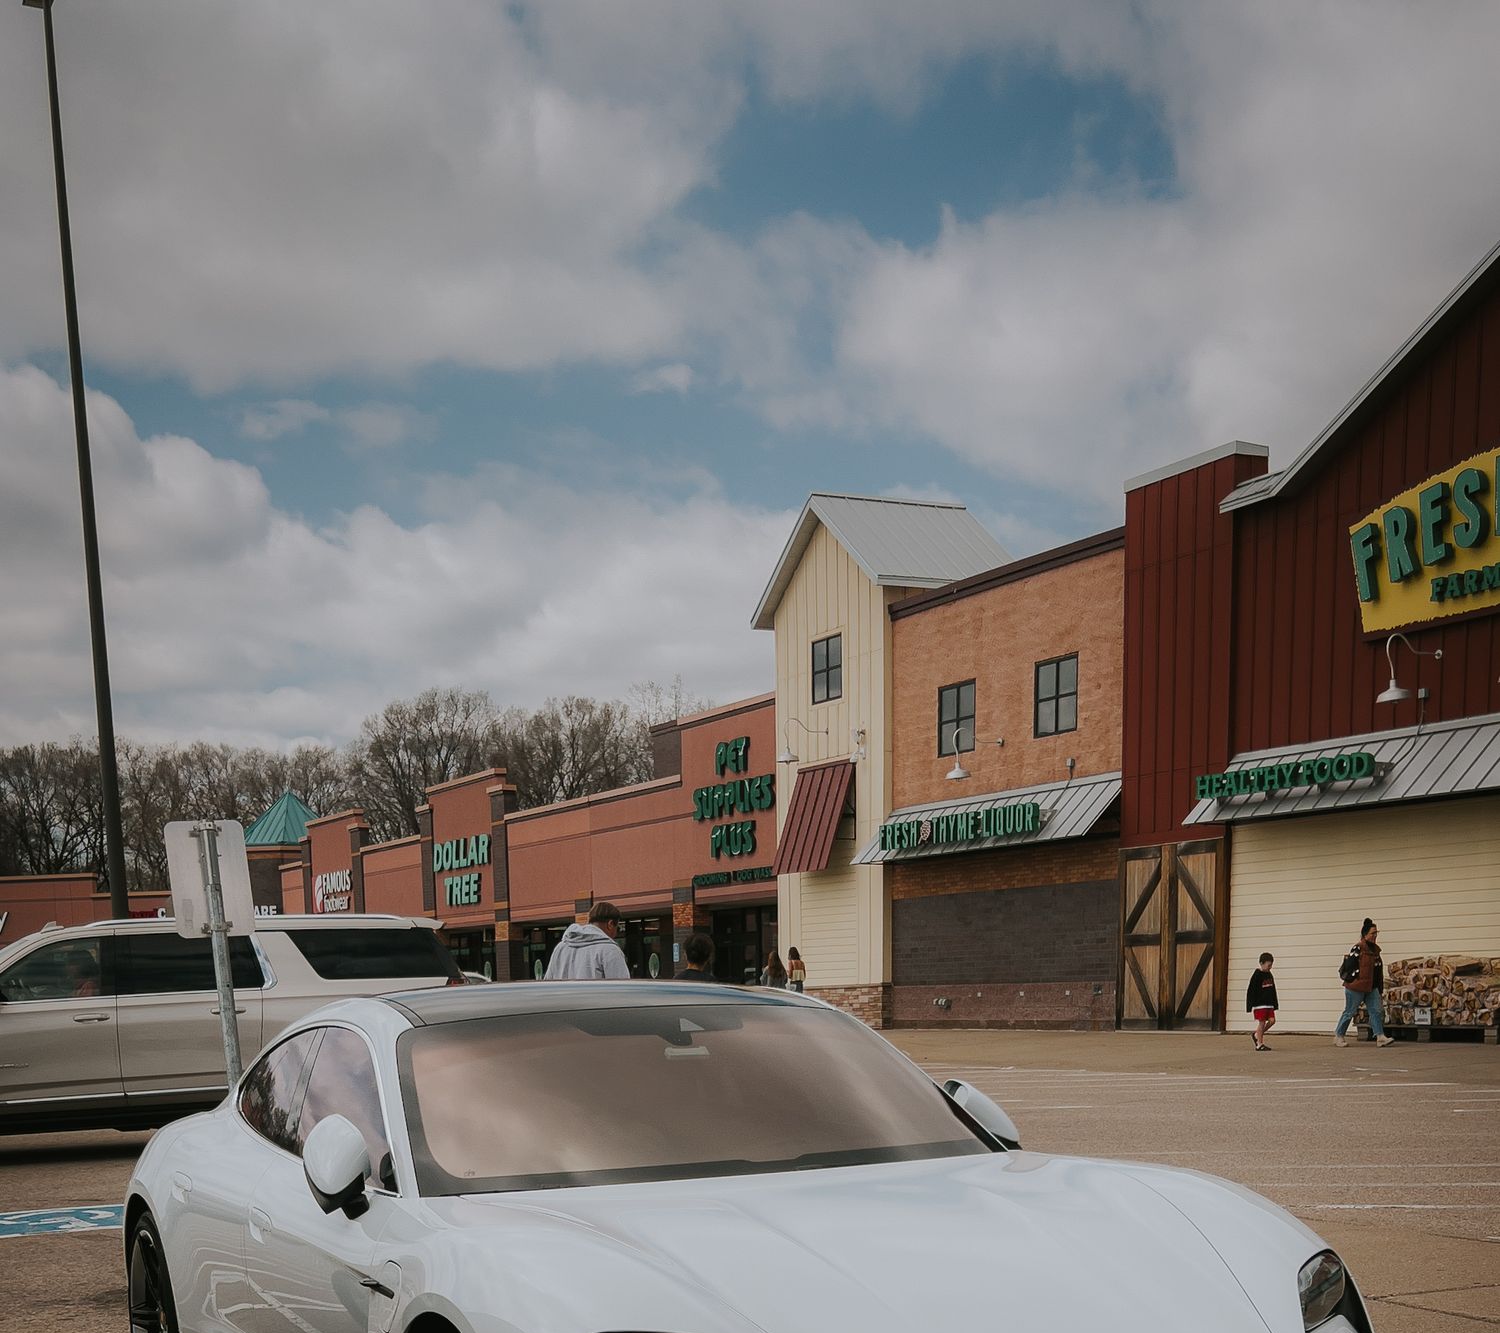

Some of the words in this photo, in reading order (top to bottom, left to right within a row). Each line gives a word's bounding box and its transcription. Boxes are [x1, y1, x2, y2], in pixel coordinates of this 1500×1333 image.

[1351, 456, 1500, 602] FRES
[715, 736, 750, 777] PET
[1196, 762, 1298, 800] HEALTHY
[1300, 752, 1375, 786] FOOD
[693, 773, 775, 821] SUPPLIES
[711, 820, 756, 859] PLUS
[879, 820, 918, 850] FRESH
[931, 812, 976, 844] THYME
[981, 803, 1037, 838] LIQUOR
[433, 833, 490, 872] DOLLAR
[322, 869, 351, 895] FAMOUS
[444, 873, 481, 905] TREE
